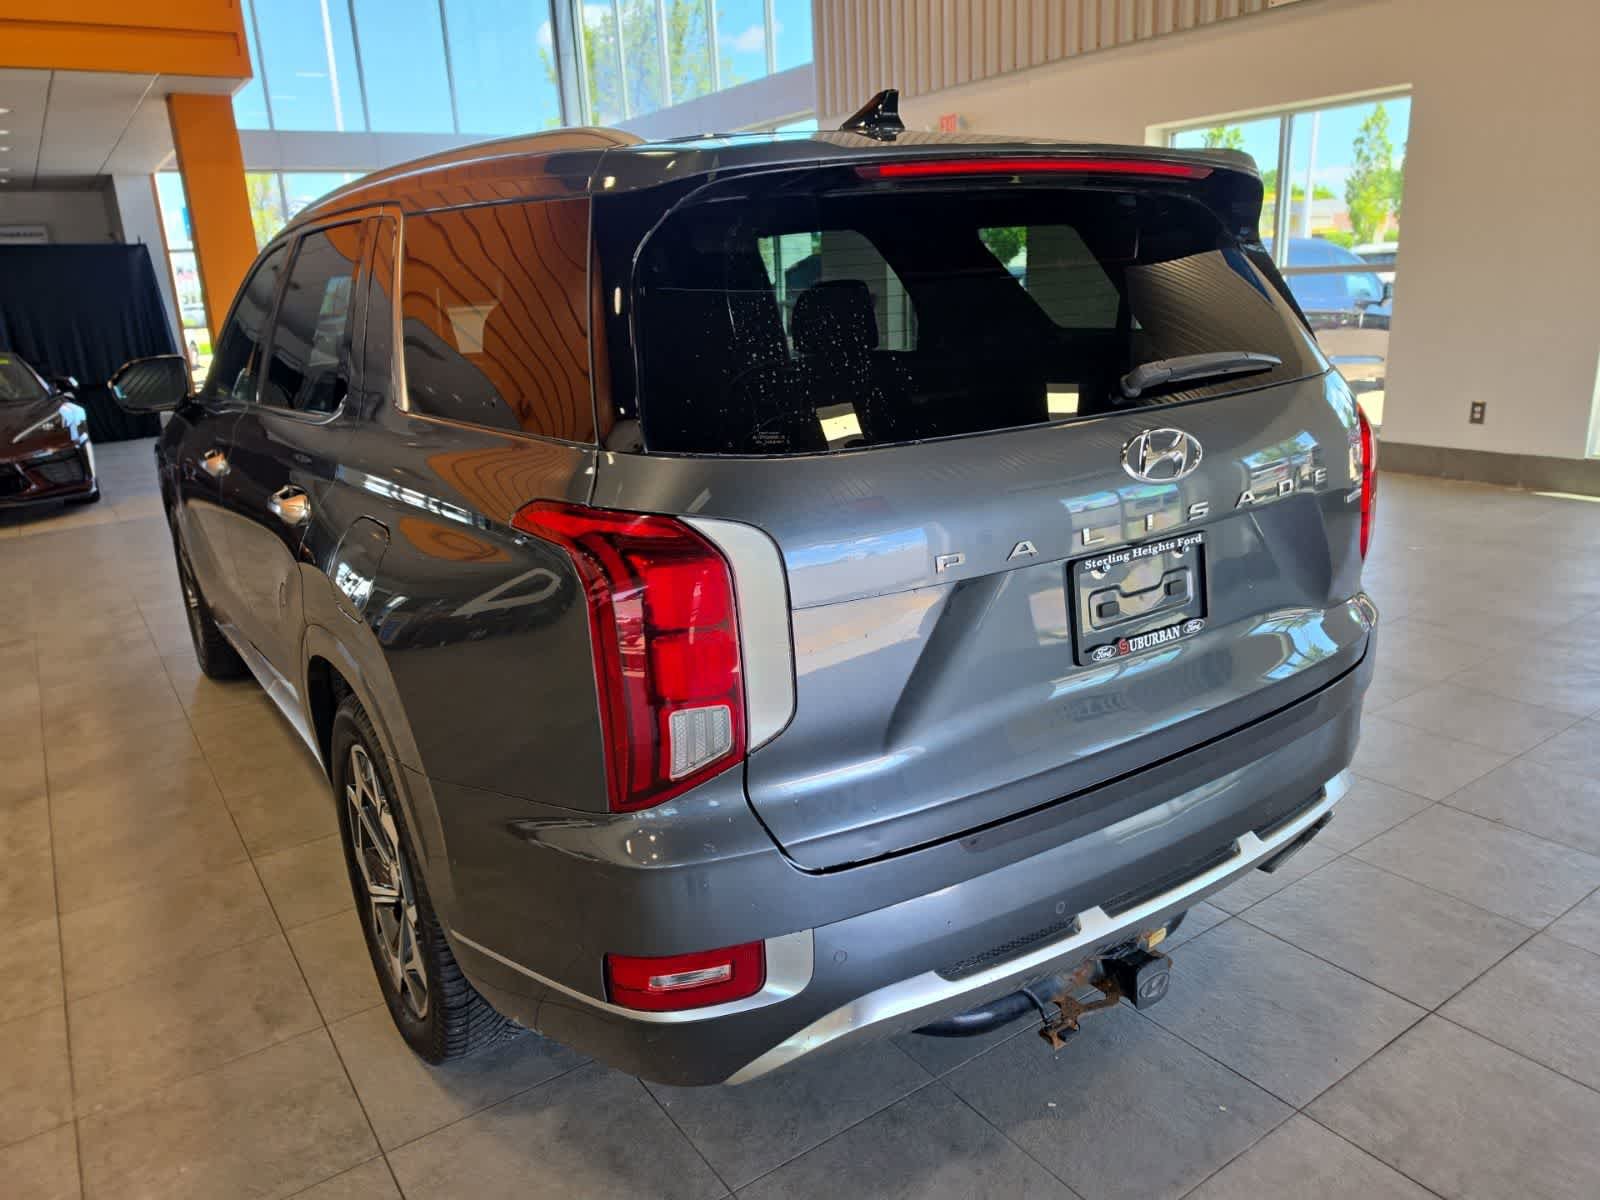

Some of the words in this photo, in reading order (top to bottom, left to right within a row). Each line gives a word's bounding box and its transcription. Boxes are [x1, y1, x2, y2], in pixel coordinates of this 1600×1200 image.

[935, 468, 1327, 575] PALISADE
[1085, 553, 1130, 569] Sterling
[1132, 543, 1175, 558] Heights
[1177, 534, 1203, 547] Ford
[1119, 626, 1180, 654] SUBURBAN
